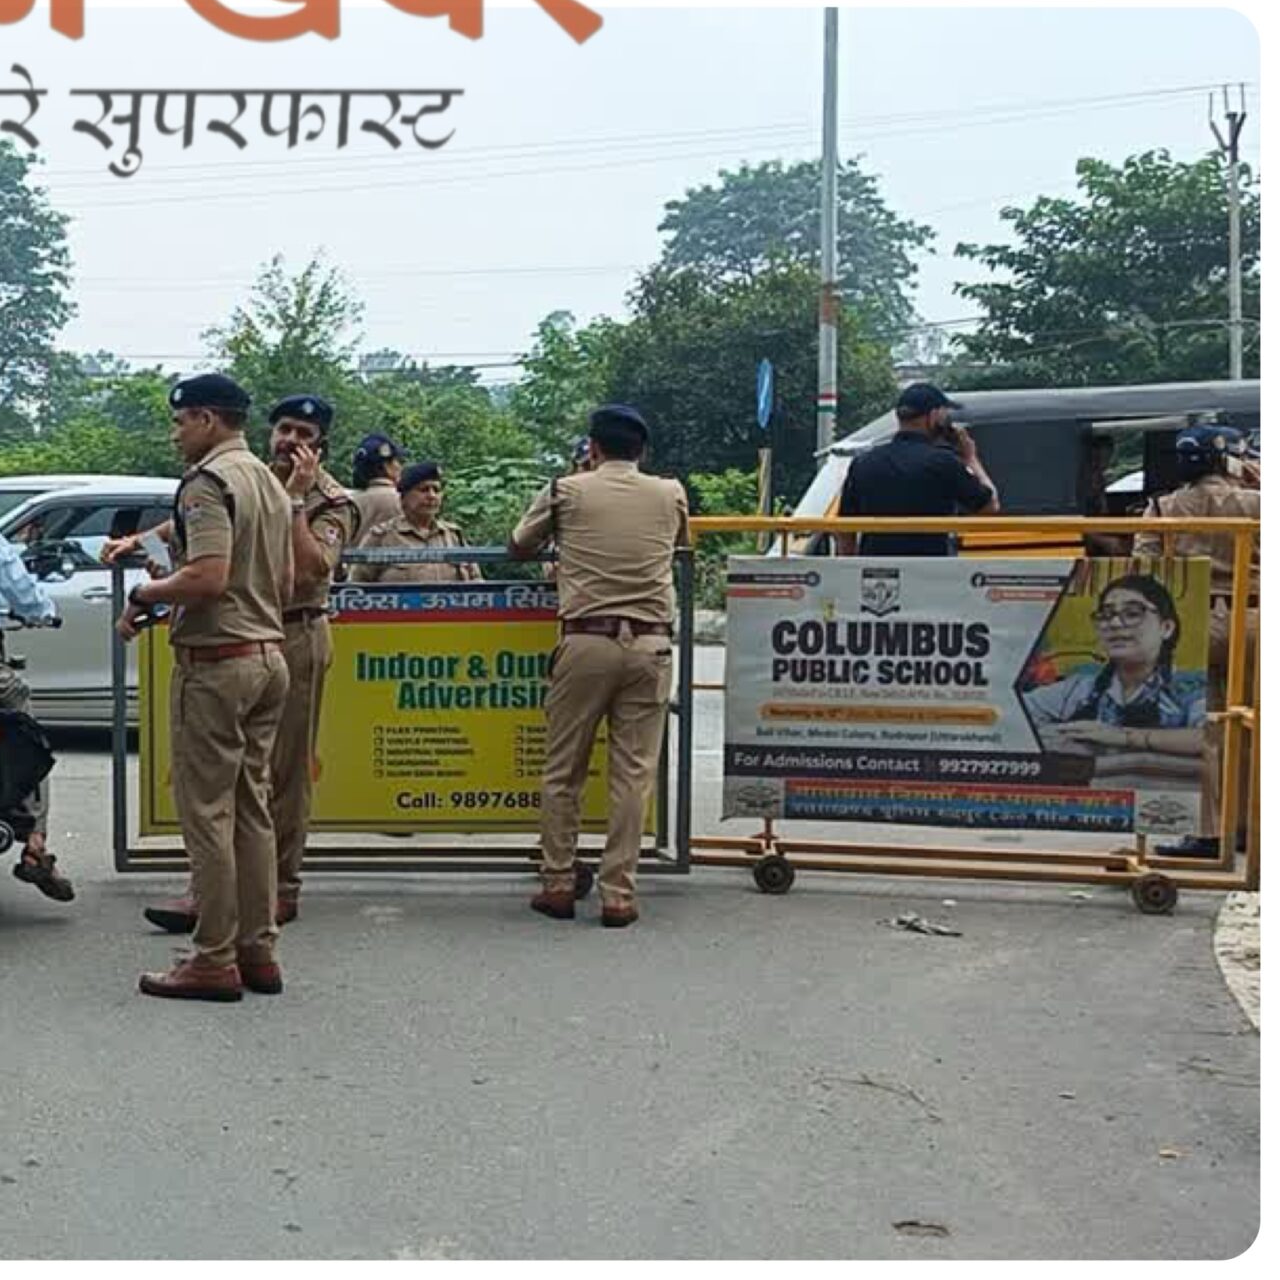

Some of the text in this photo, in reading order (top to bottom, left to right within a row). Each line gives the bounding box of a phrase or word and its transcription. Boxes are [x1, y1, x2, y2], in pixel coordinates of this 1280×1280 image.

[772, 620, 990, 658] COLUMBUS
[356, 651, 459, 680] Indoor
[467, 654, 488, 680] &
[772, 659, 989, 686] PUBLIC SCHOOL
[734, 752, 1041, 776] For Admissions Contact 9927927999
[396, 791, 442, 808] Call:
